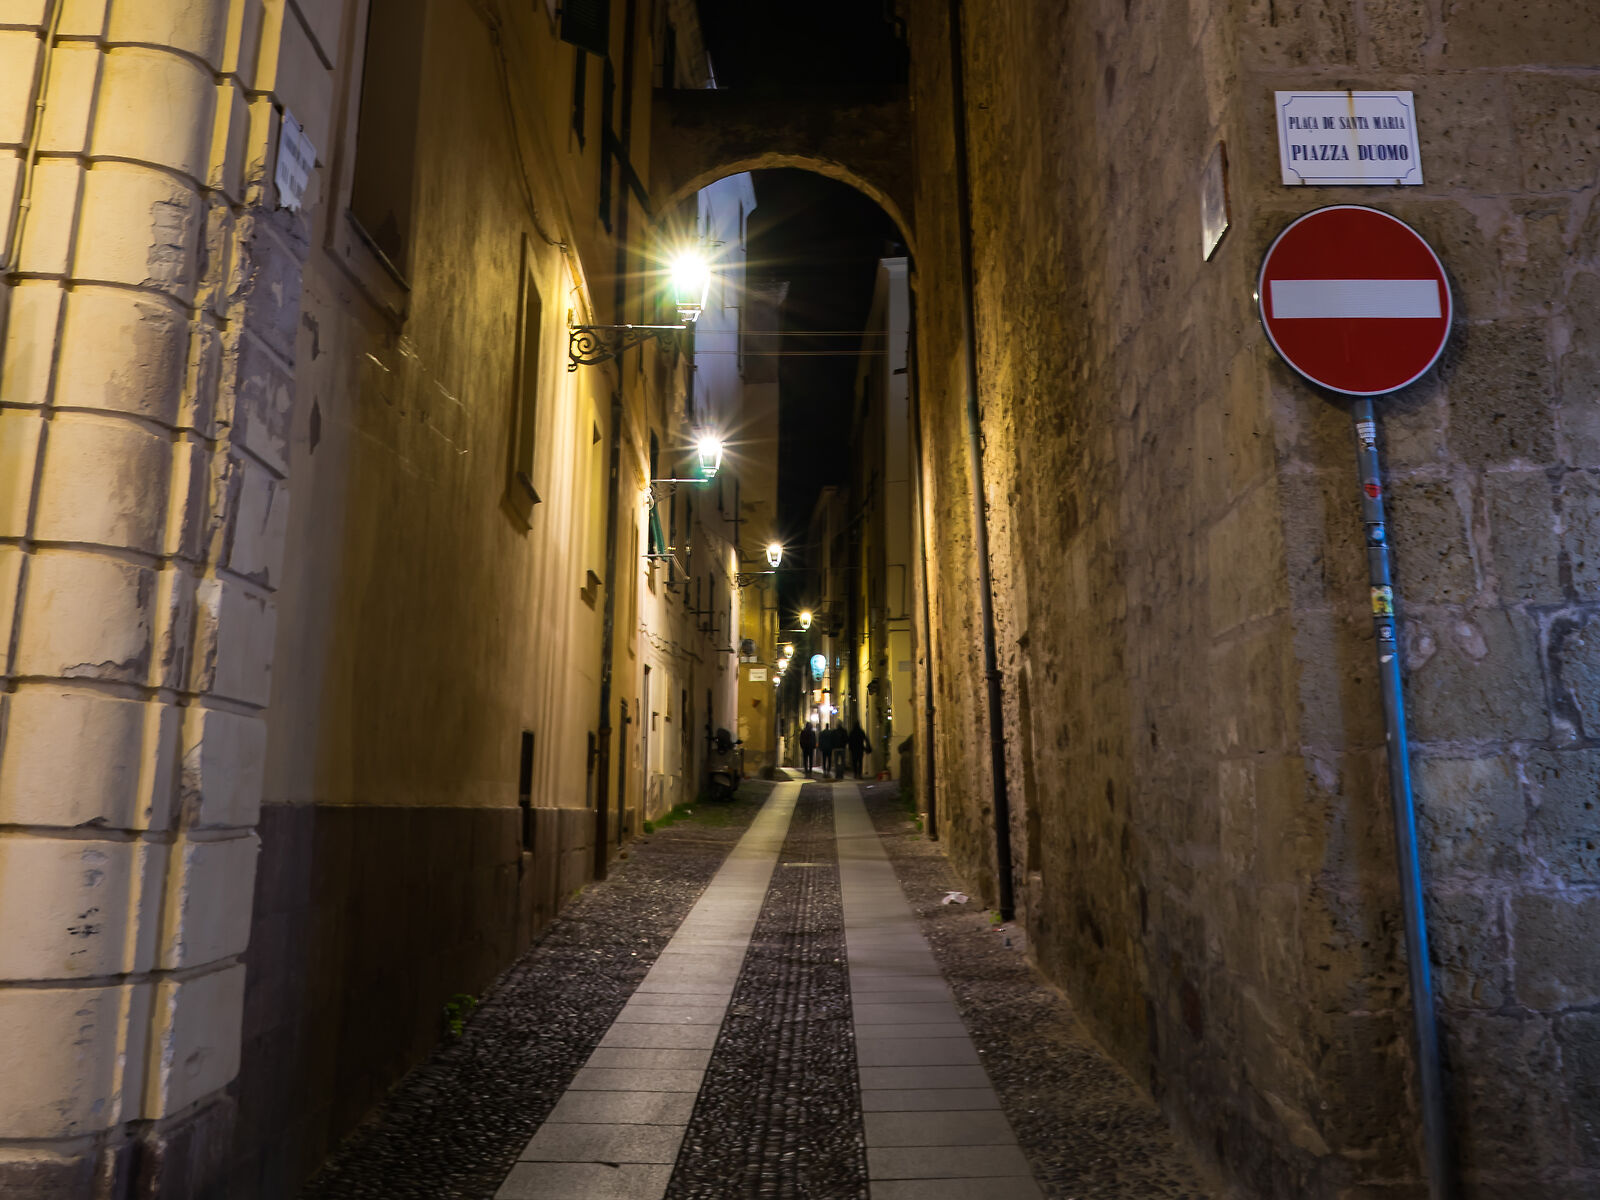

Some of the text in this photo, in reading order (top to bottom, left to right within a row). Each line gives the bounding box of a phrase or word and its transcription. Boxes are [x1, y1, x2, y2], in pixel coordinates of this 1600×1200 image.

[1322, 116, 1335, 130] DE
[1339, 116, 1370, 130] SANTA
[1373, 116, 1406, 130] MARIA
[1291, 144, 1409, 161] PIAZZA DUOMO
